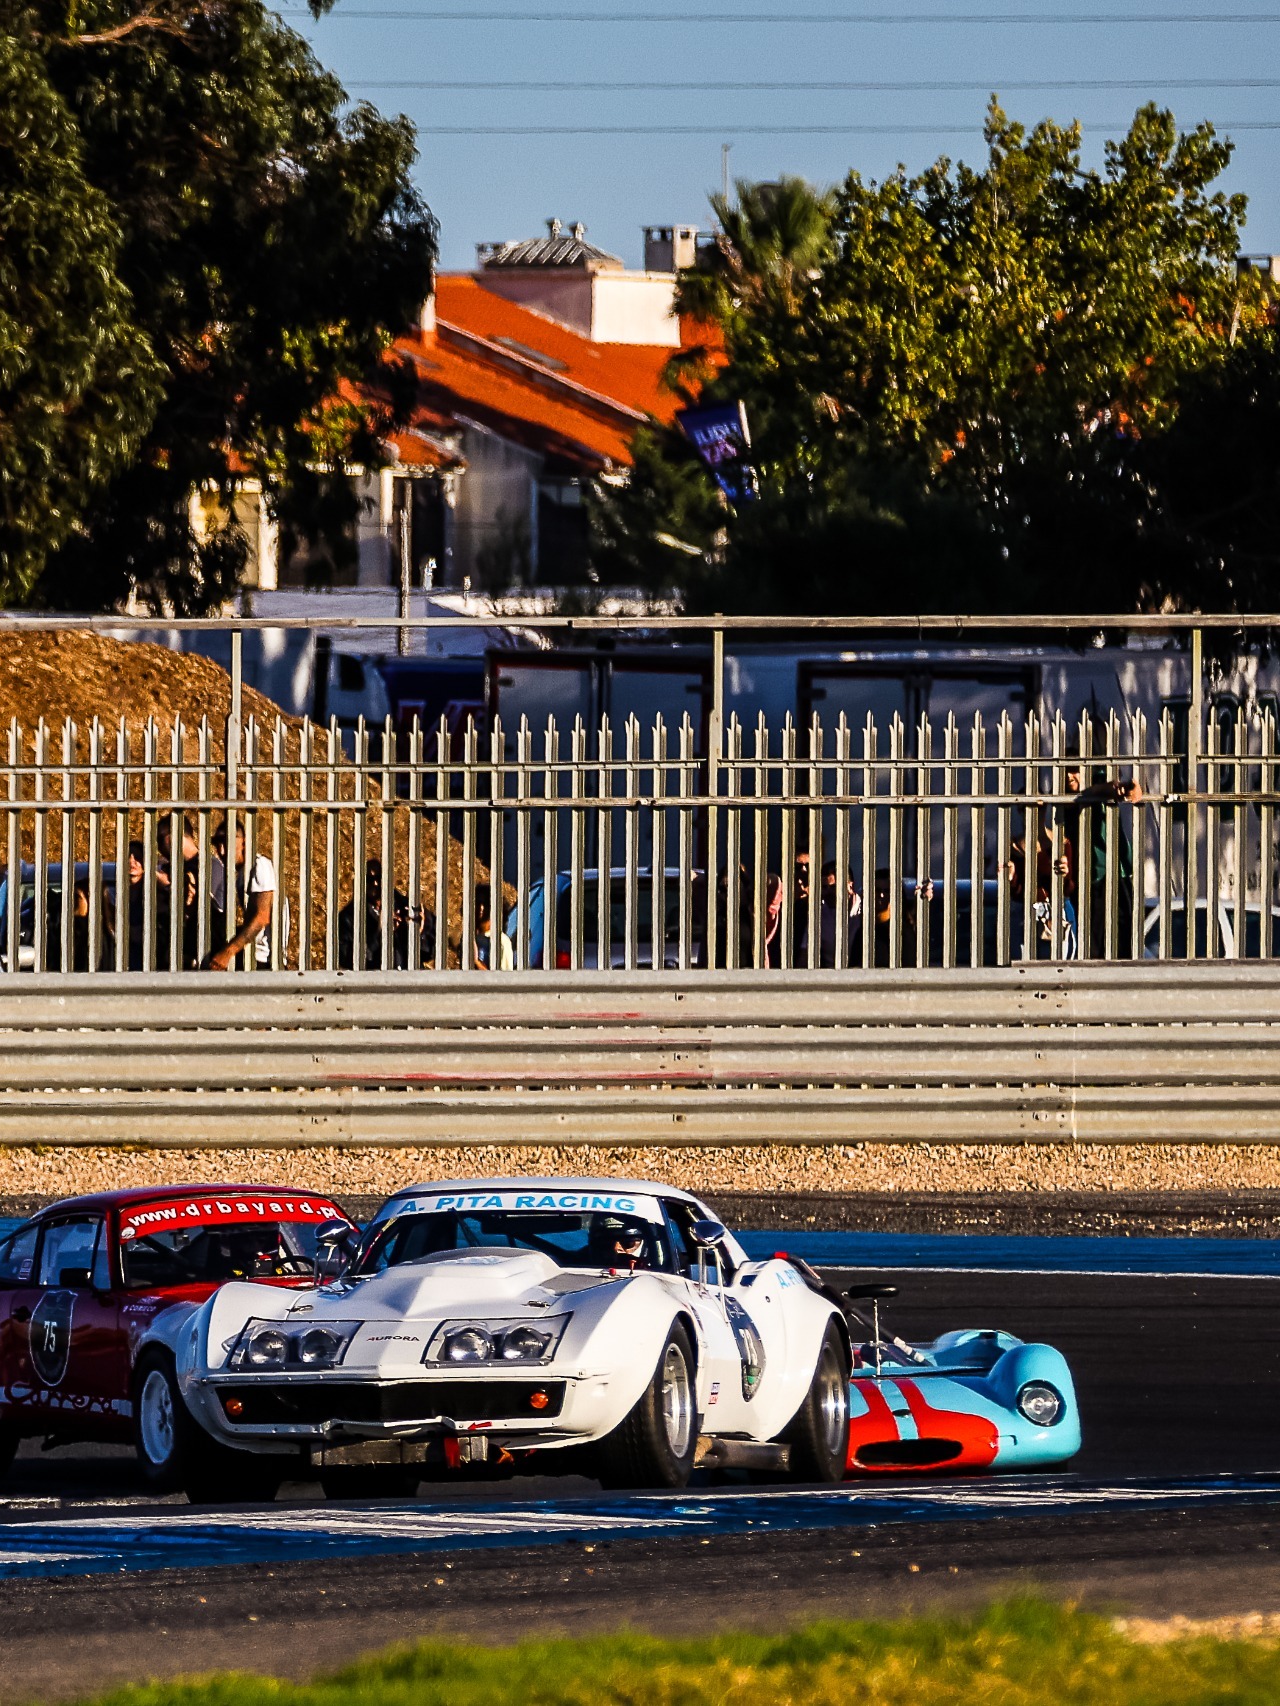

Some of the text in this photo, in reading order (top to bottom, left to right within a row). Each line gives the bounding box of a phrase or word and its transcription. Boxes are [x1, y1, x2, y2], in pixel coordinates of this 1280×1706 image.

[435, 1196, 503, 1210] PITA
[515, 1195, 636, 1212] RACING
[43, 1320, 57, 1353] 75
[4, 1380, 119, 1414] Carrera
